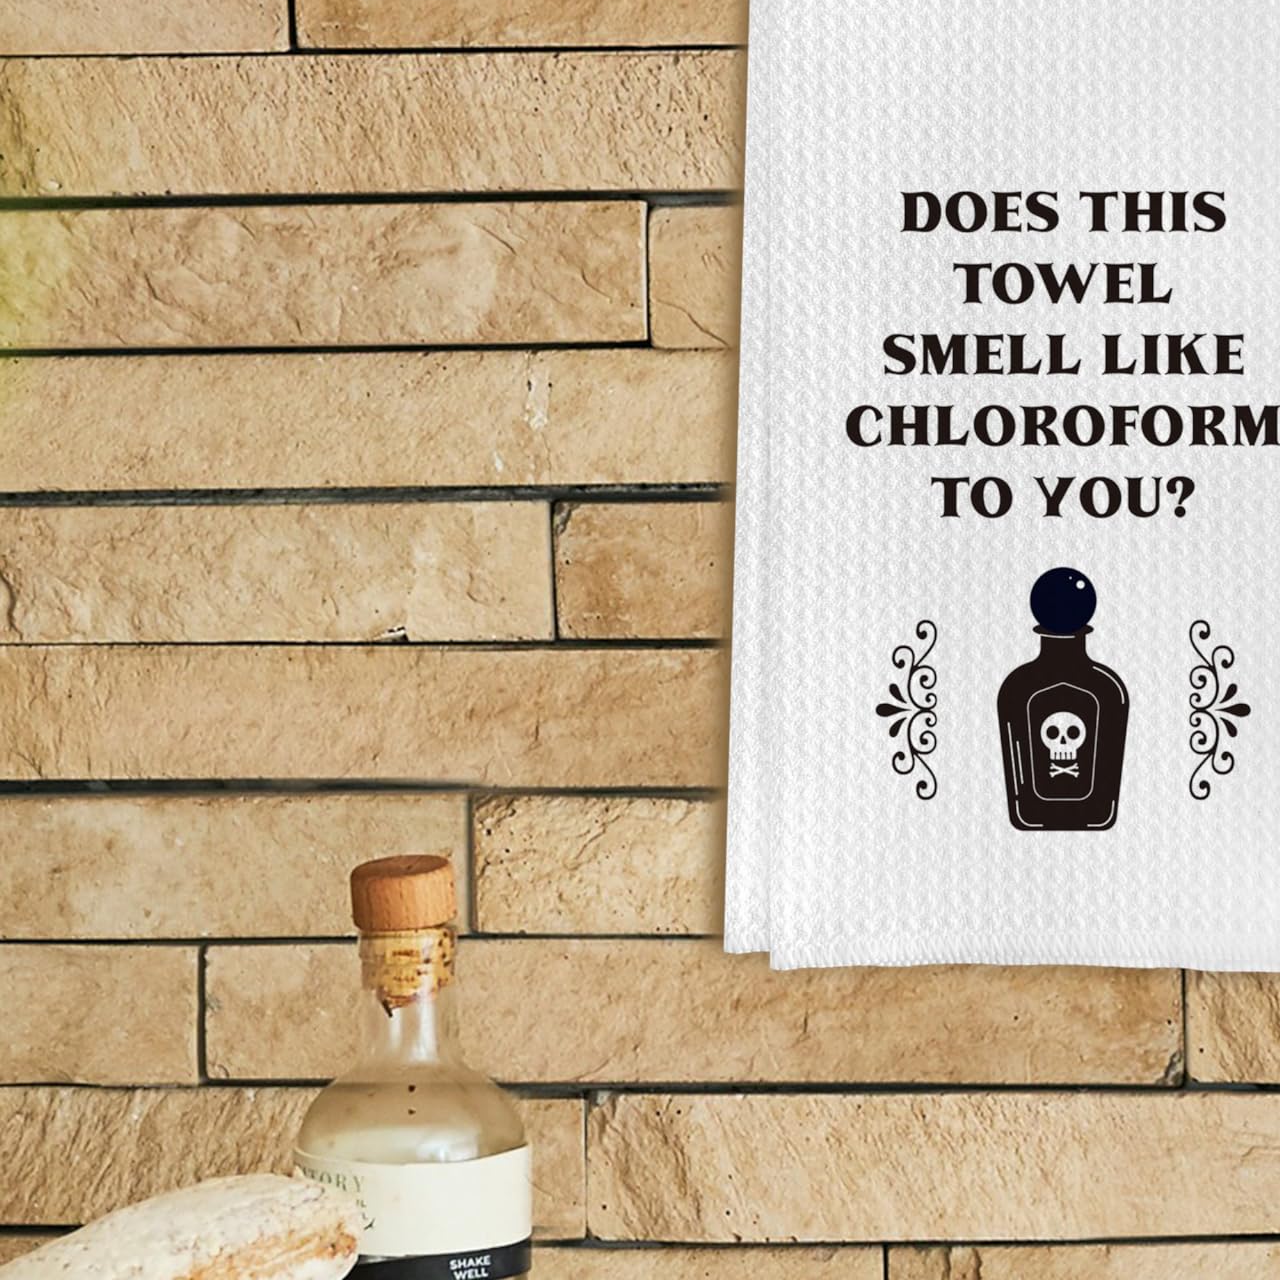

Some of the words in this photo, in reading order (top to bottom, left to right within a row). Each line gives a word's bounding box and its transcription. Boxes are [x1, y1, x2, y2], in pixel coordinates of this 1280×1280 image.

[901, 191, 1058, 232] DOES
[1080, 192, 1226, 233] THIS
[954, 263, 1172, 304] TOWEL
[883, 334, 1081, 375] SMELL
[1103, 334, 1244, 375] LIKE
[846, 405, 1280, 447] CHLOROFORM
[931, 477, 1013, 518] TO
[1034, 477, 1194, 518] YOU?
[450, 1255, 491, 1270] SHAKE
[453, 1268, 489, 1280] WELL
